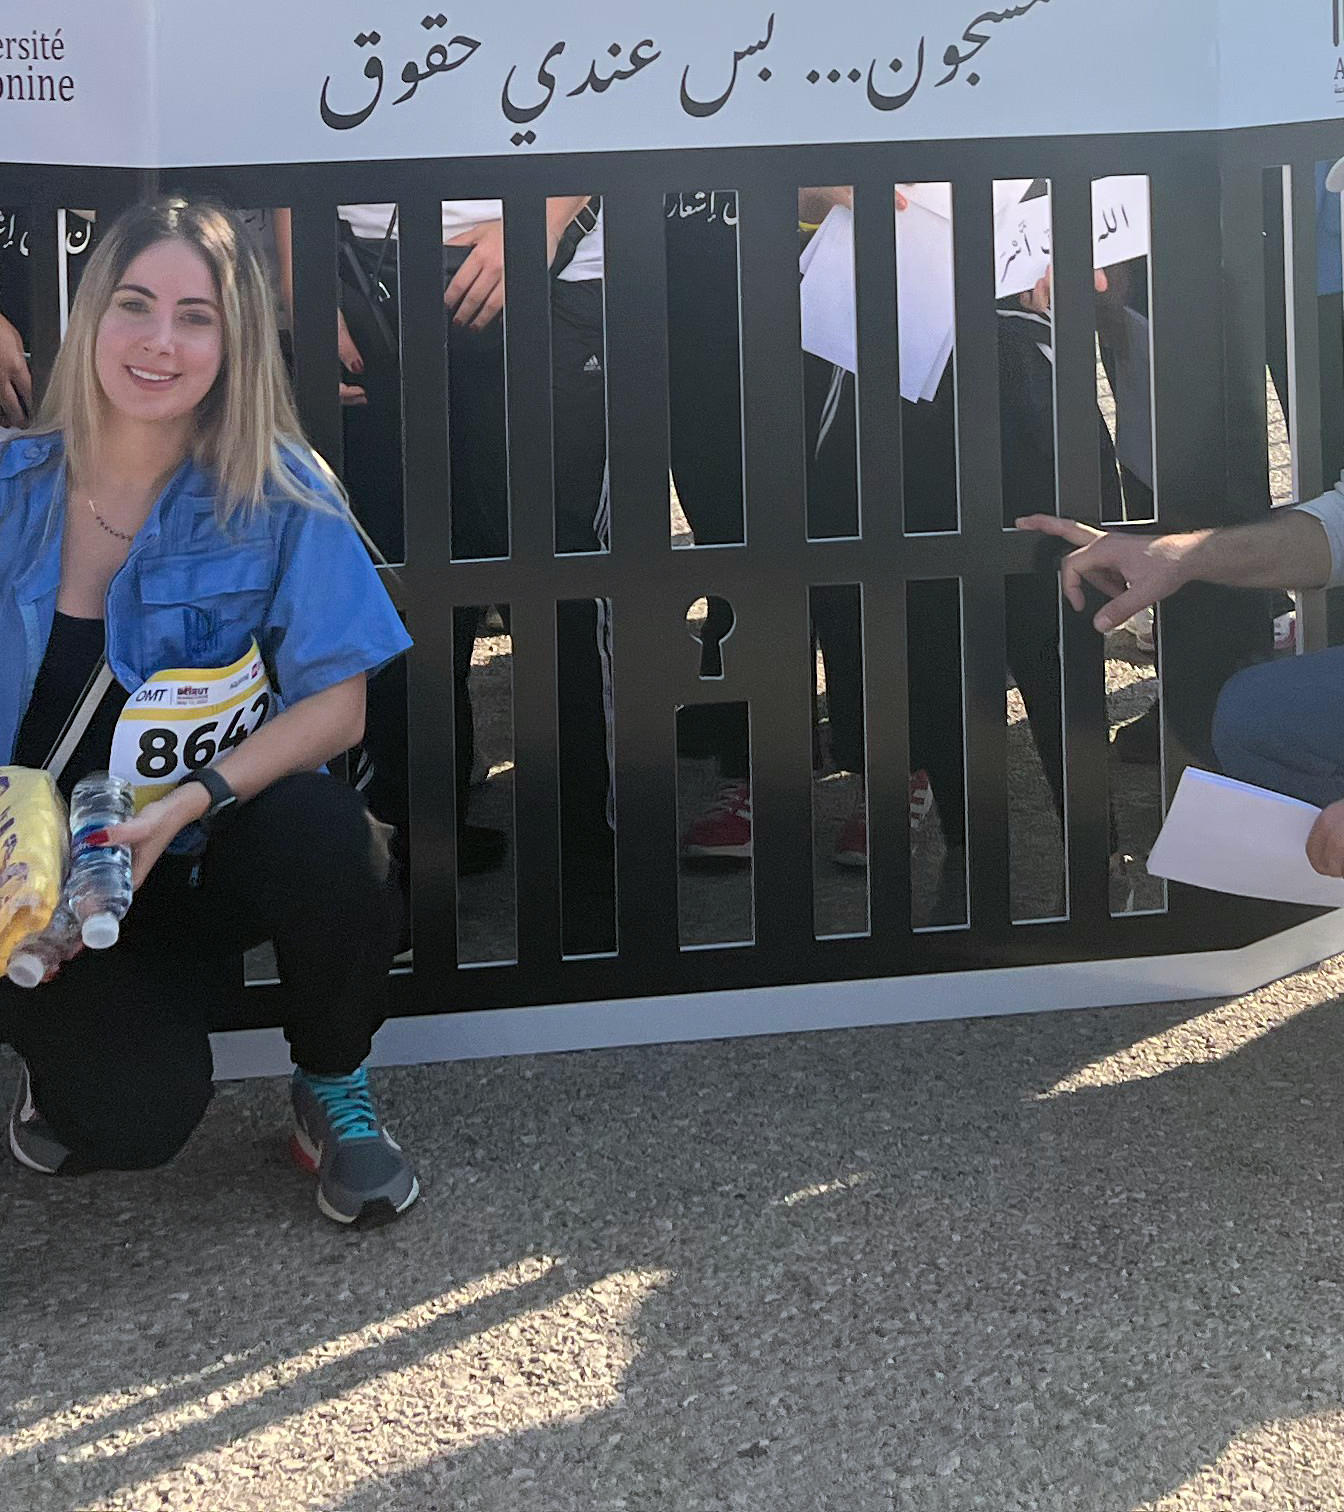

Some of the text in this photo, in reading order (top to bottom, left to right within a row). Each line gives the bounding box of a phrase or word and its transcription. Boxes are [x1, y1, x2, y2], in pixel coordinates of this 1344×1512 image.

[320, 13, 482, 130] حقوق
[501, 39, 662, 147] عندي
[680, 13, 775, 118] بس
[135, 688, 168, 702] OMT
